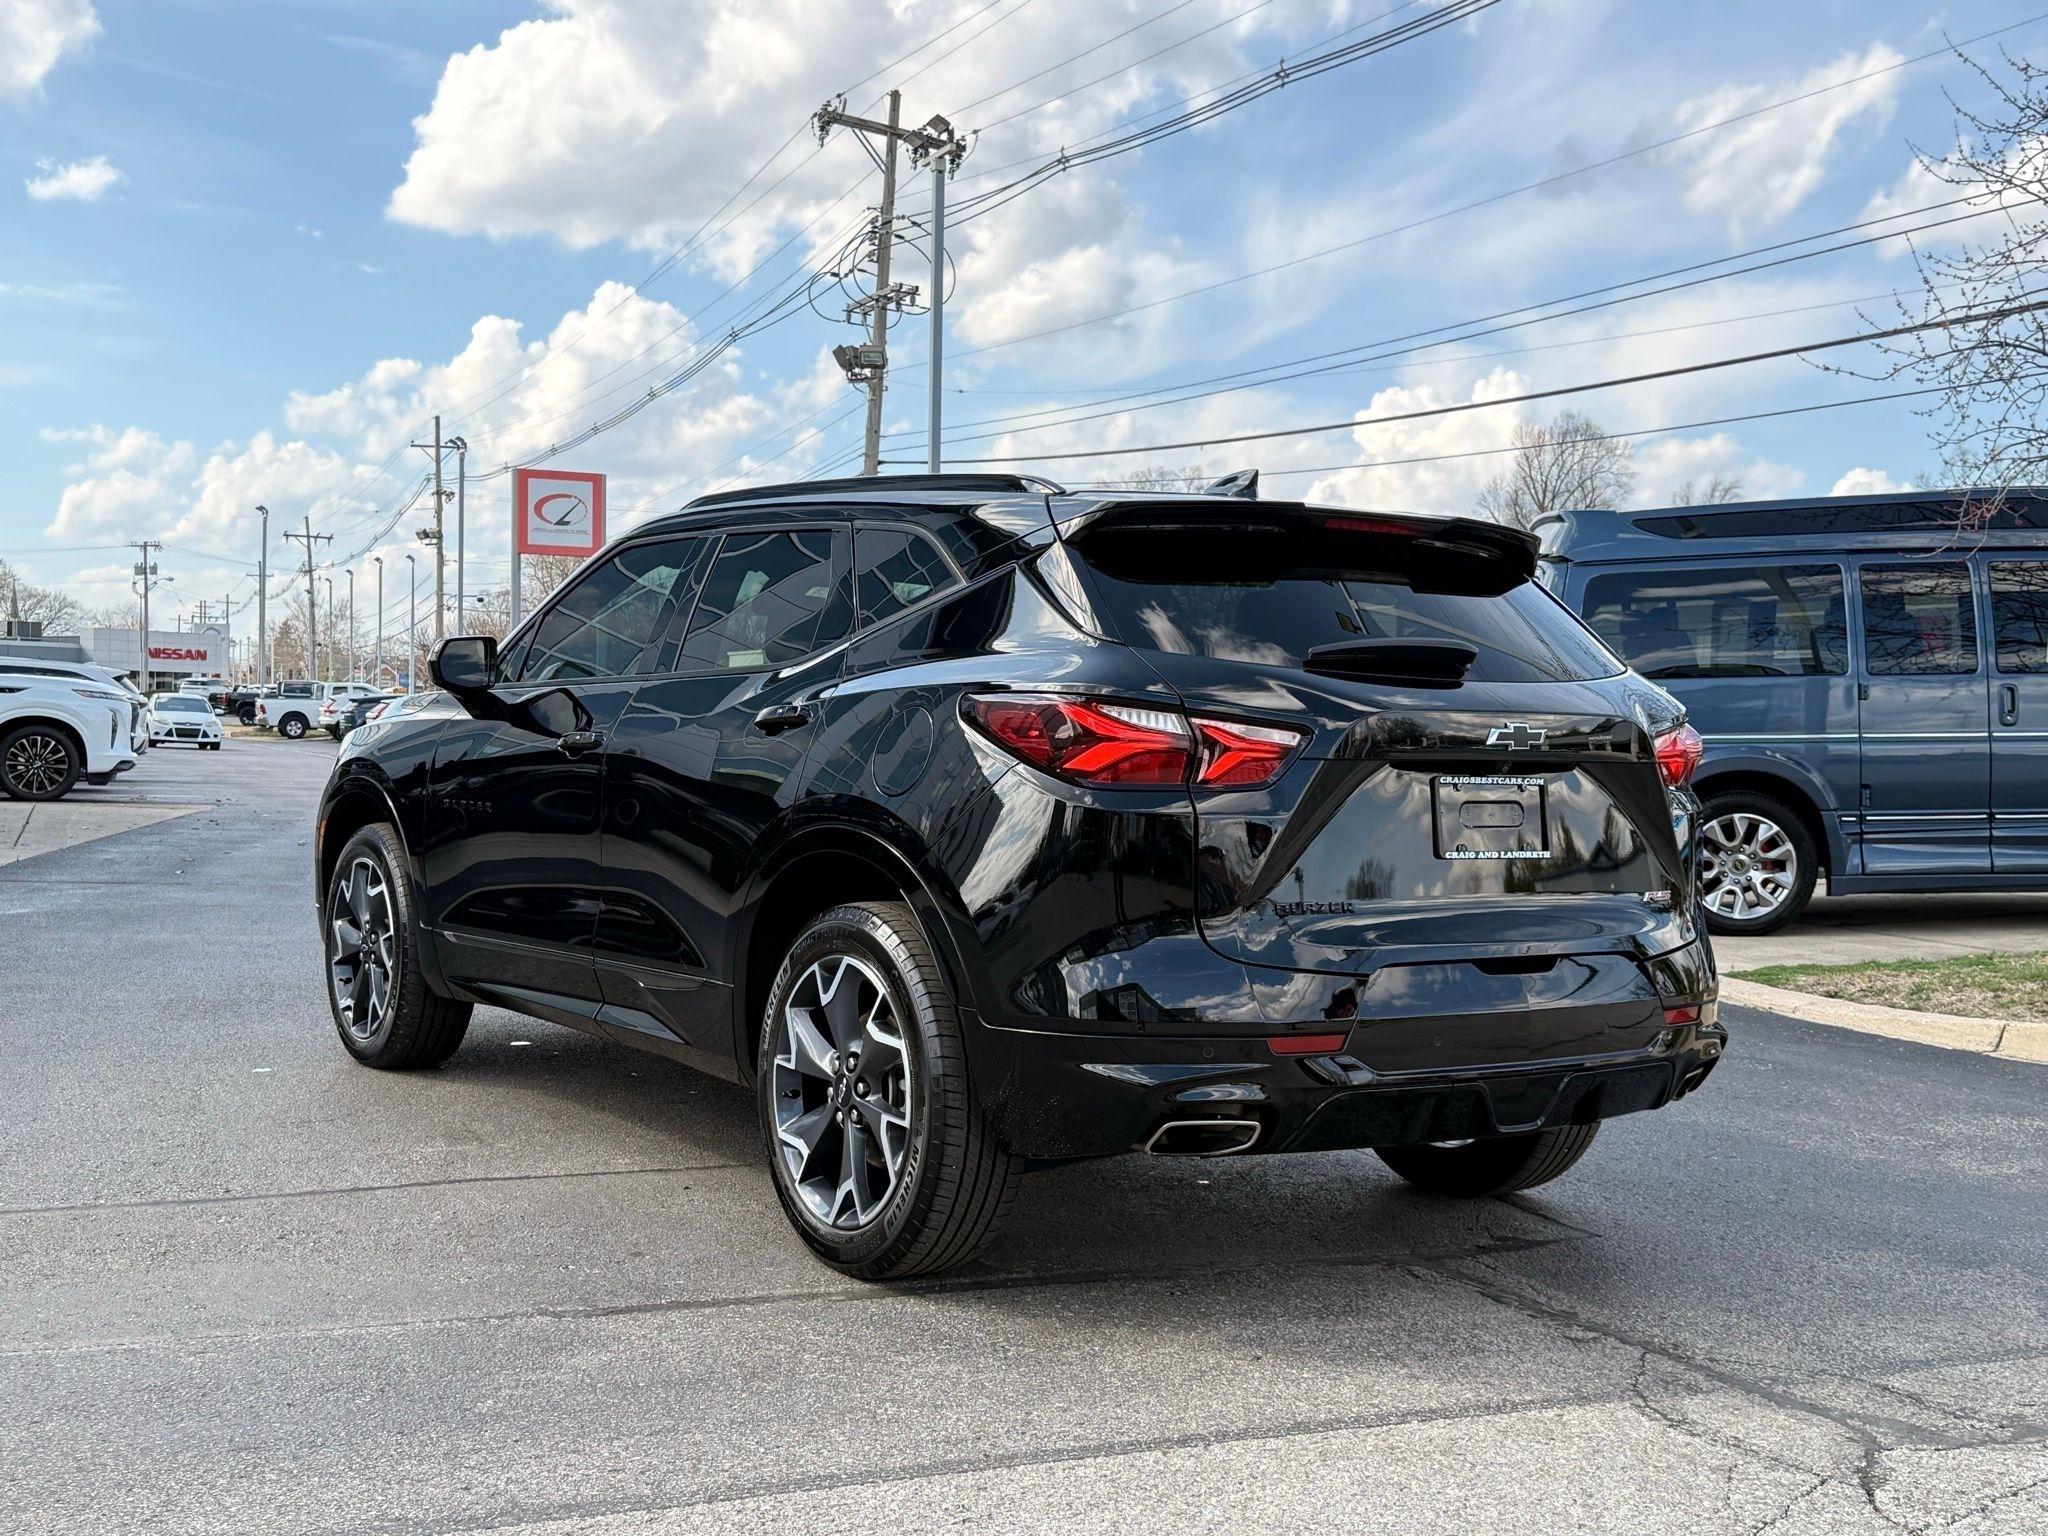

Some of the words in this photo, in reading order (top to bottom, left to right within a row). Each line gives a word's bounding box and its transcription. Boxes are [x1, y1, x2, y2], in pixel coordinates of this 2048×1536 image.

[148, 647, 207, 661] NISSAN
[1440, 776, 1544, 785] CRAIGSBESTCARS.COM
[1445, 851, 1477, 859] CRAIG
[1478, 851, 1498, 859] AND
[1500, 850, 1551, 858] LANDRETH
[886, 1143, 920, 1231] MICHELIN
